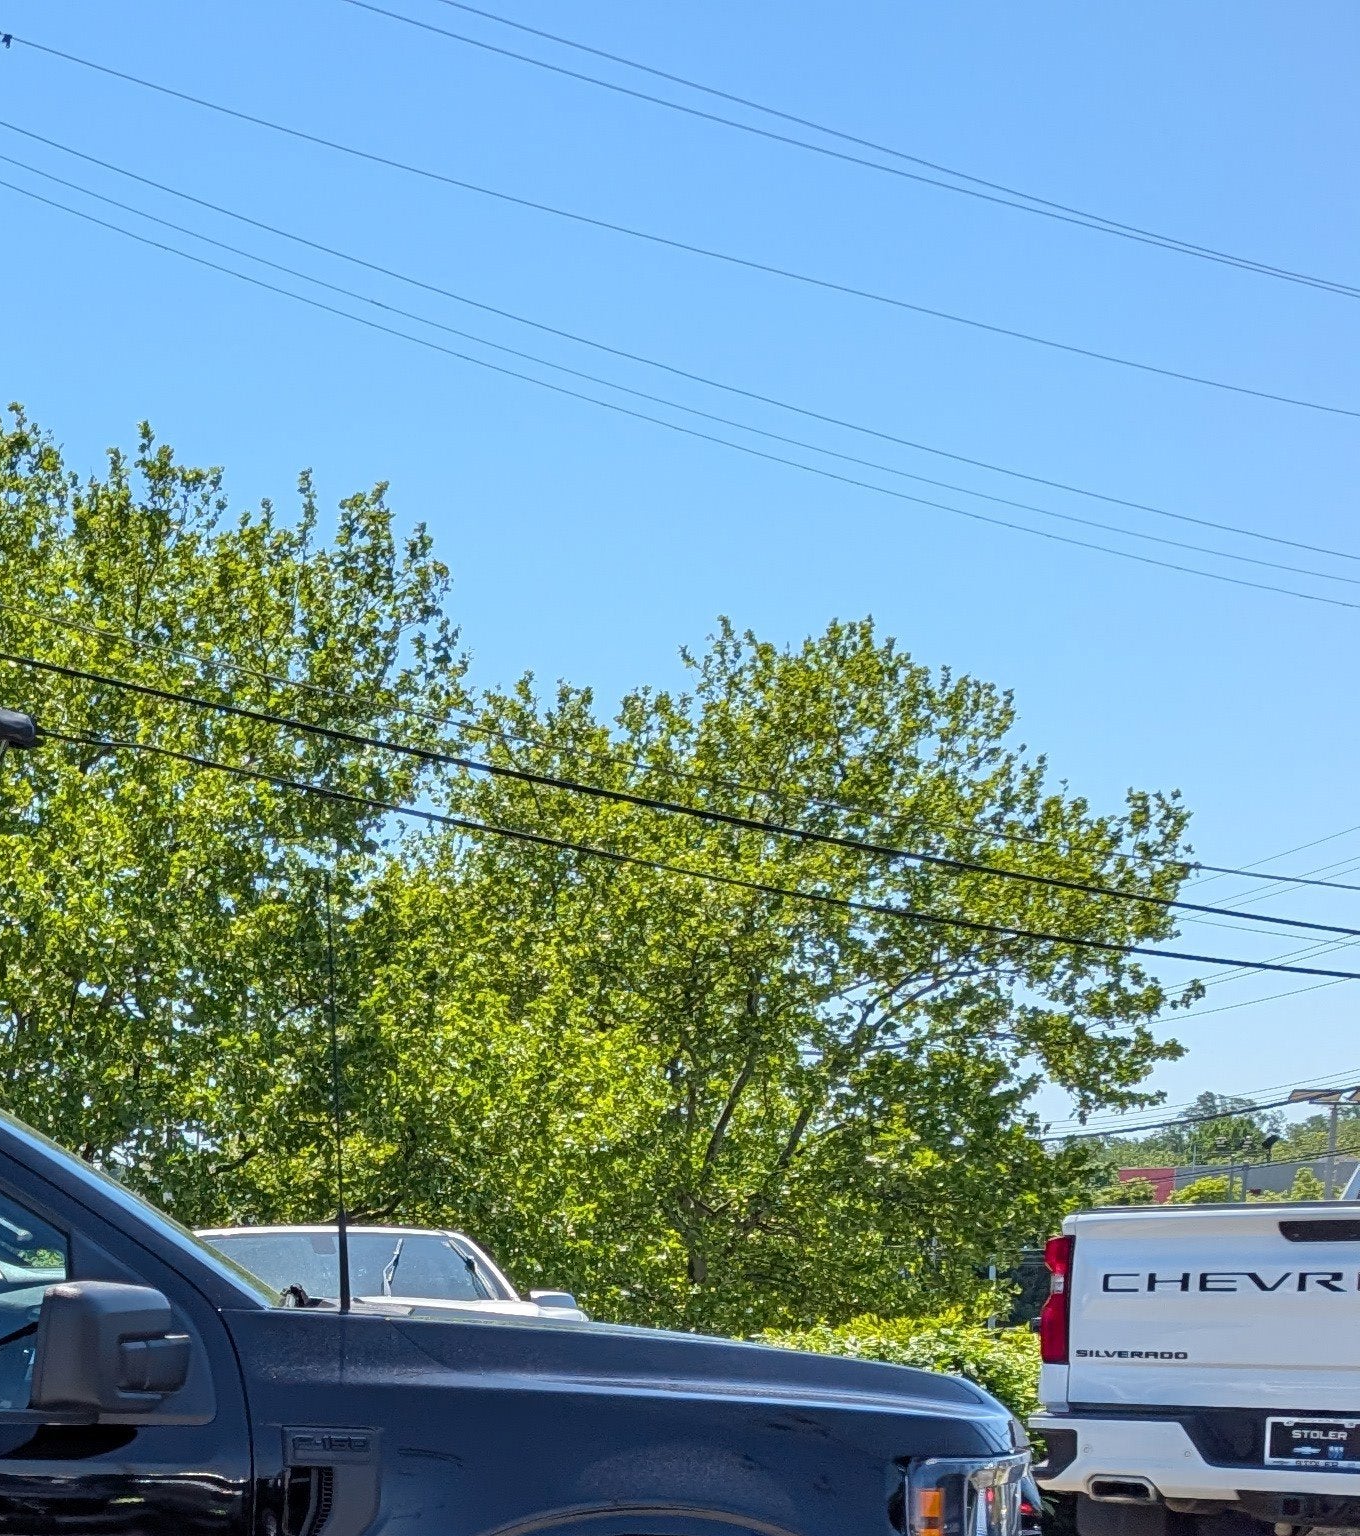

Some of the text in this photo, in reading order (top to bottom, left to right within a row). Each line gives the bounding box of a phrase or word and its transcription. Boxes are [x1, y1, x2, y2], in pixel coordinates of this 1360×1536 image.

[1102, 1272, 1360, 1293] CHEVR
[1075, 1349, 1188, 1360] SILVERADO
[1292, 1429, 1348, 1441] STOLER
